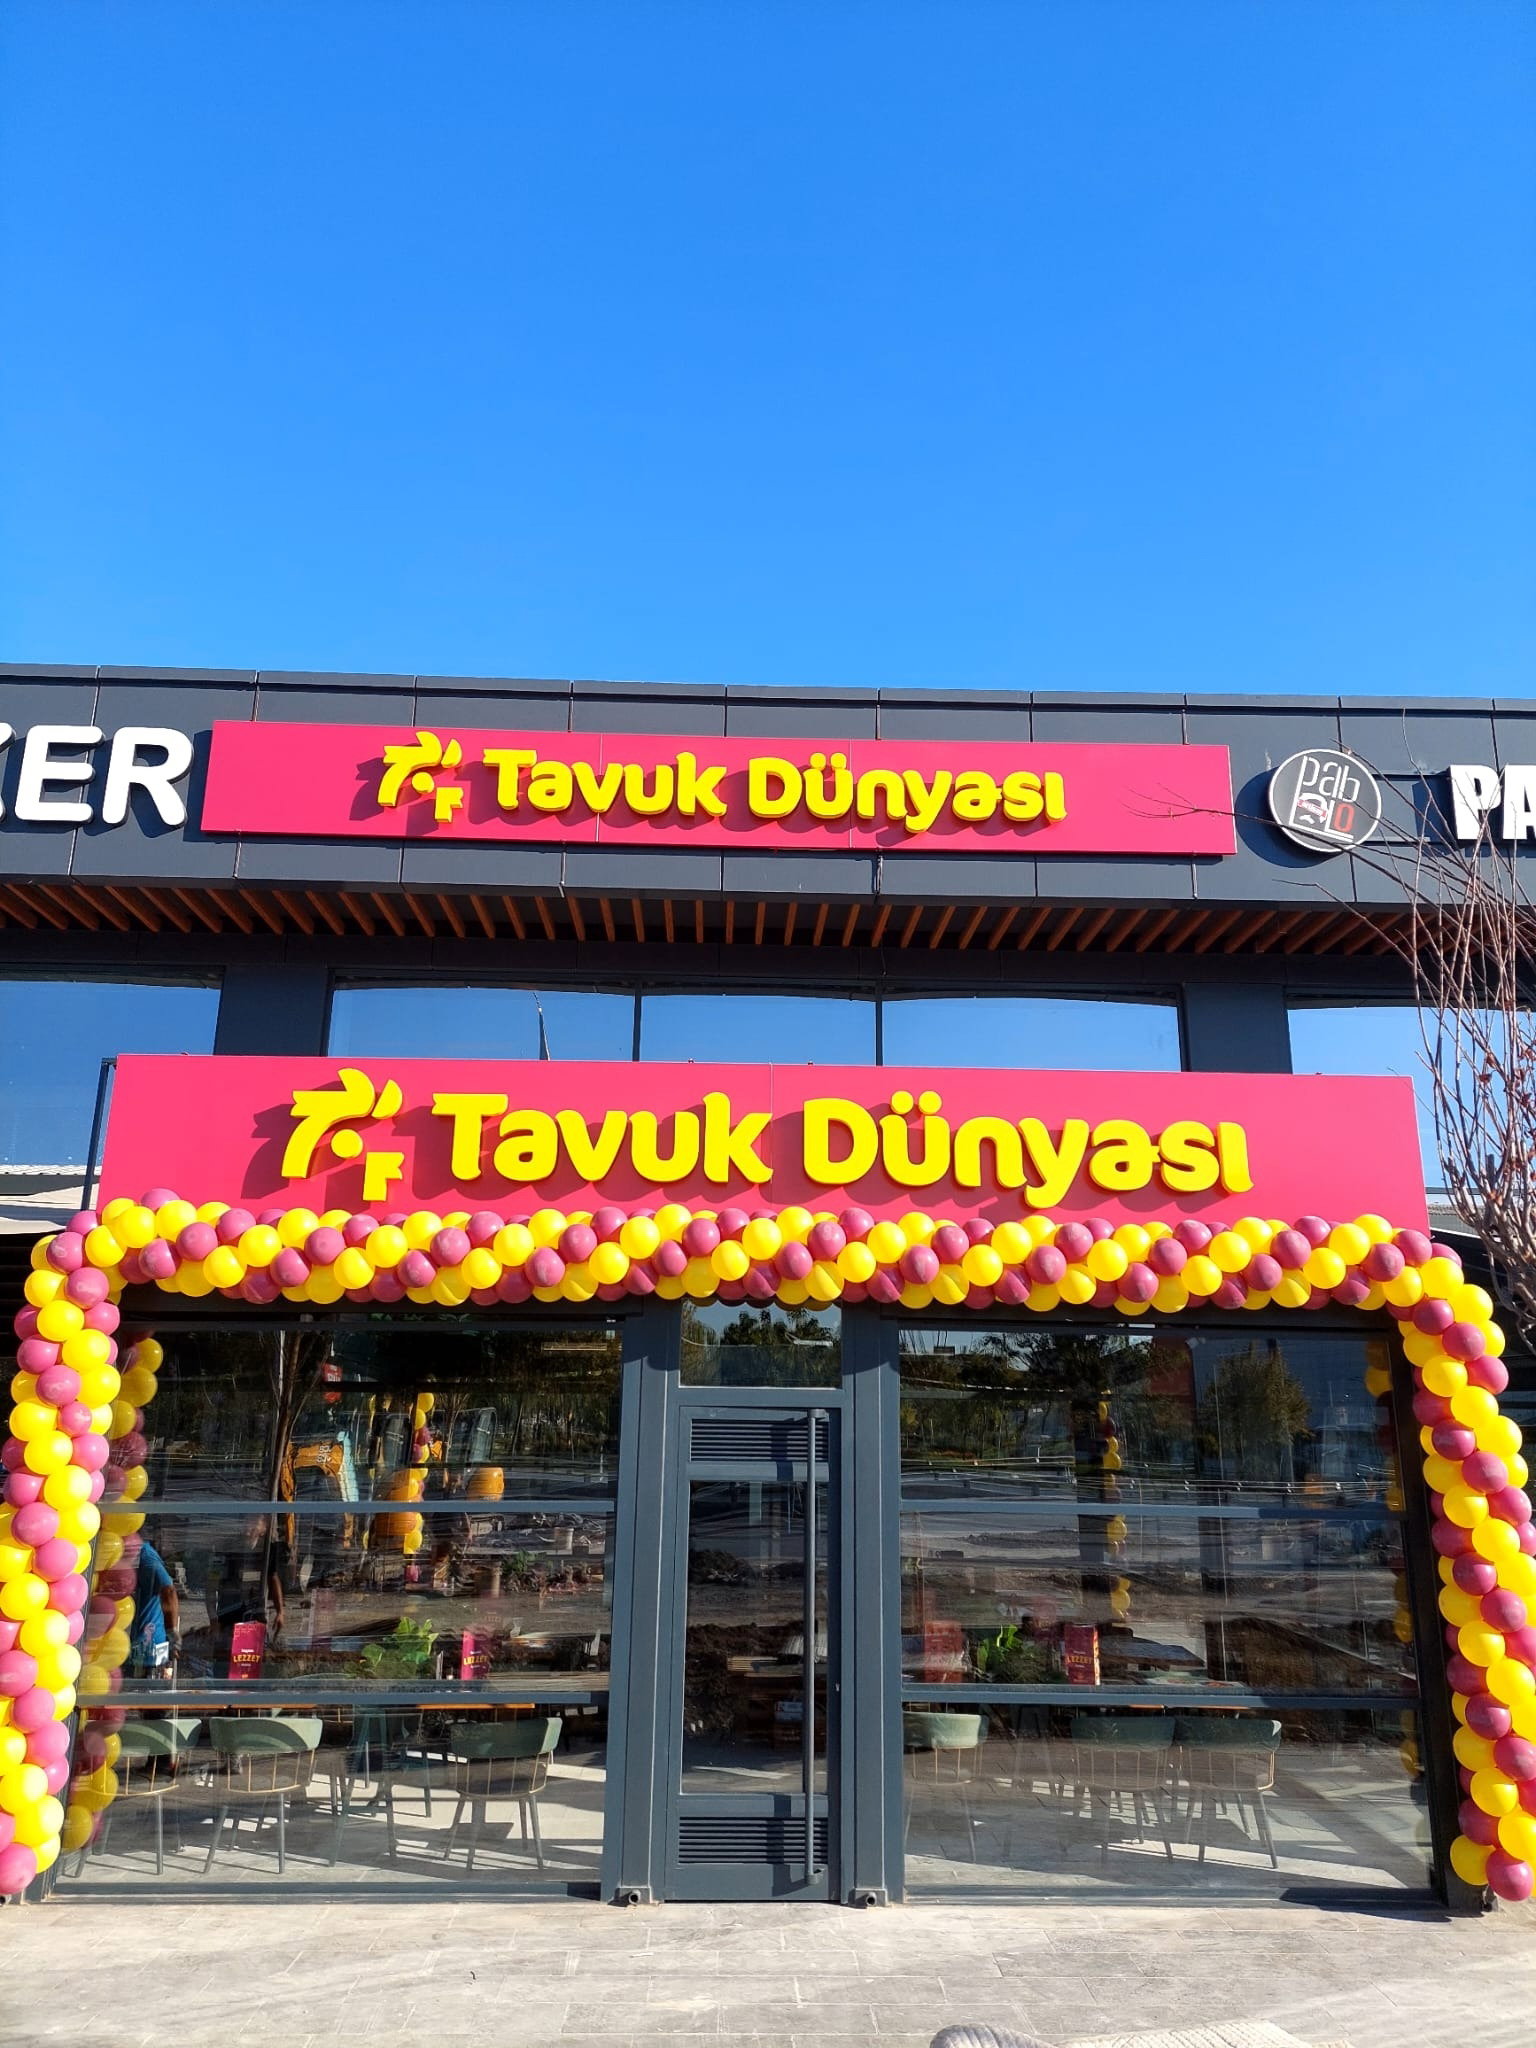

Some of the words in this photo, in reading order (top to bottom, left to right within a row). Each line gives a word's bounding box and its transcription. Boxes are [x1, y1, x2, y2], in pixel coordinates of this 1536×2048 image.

[483, 749, 728, 819] Tavuk
[748, 752, 1068, 833] Dünyası
[431, 1091, 774, 1184] Tavuk
[803, 1091, 1254, 1209] Dünyası
